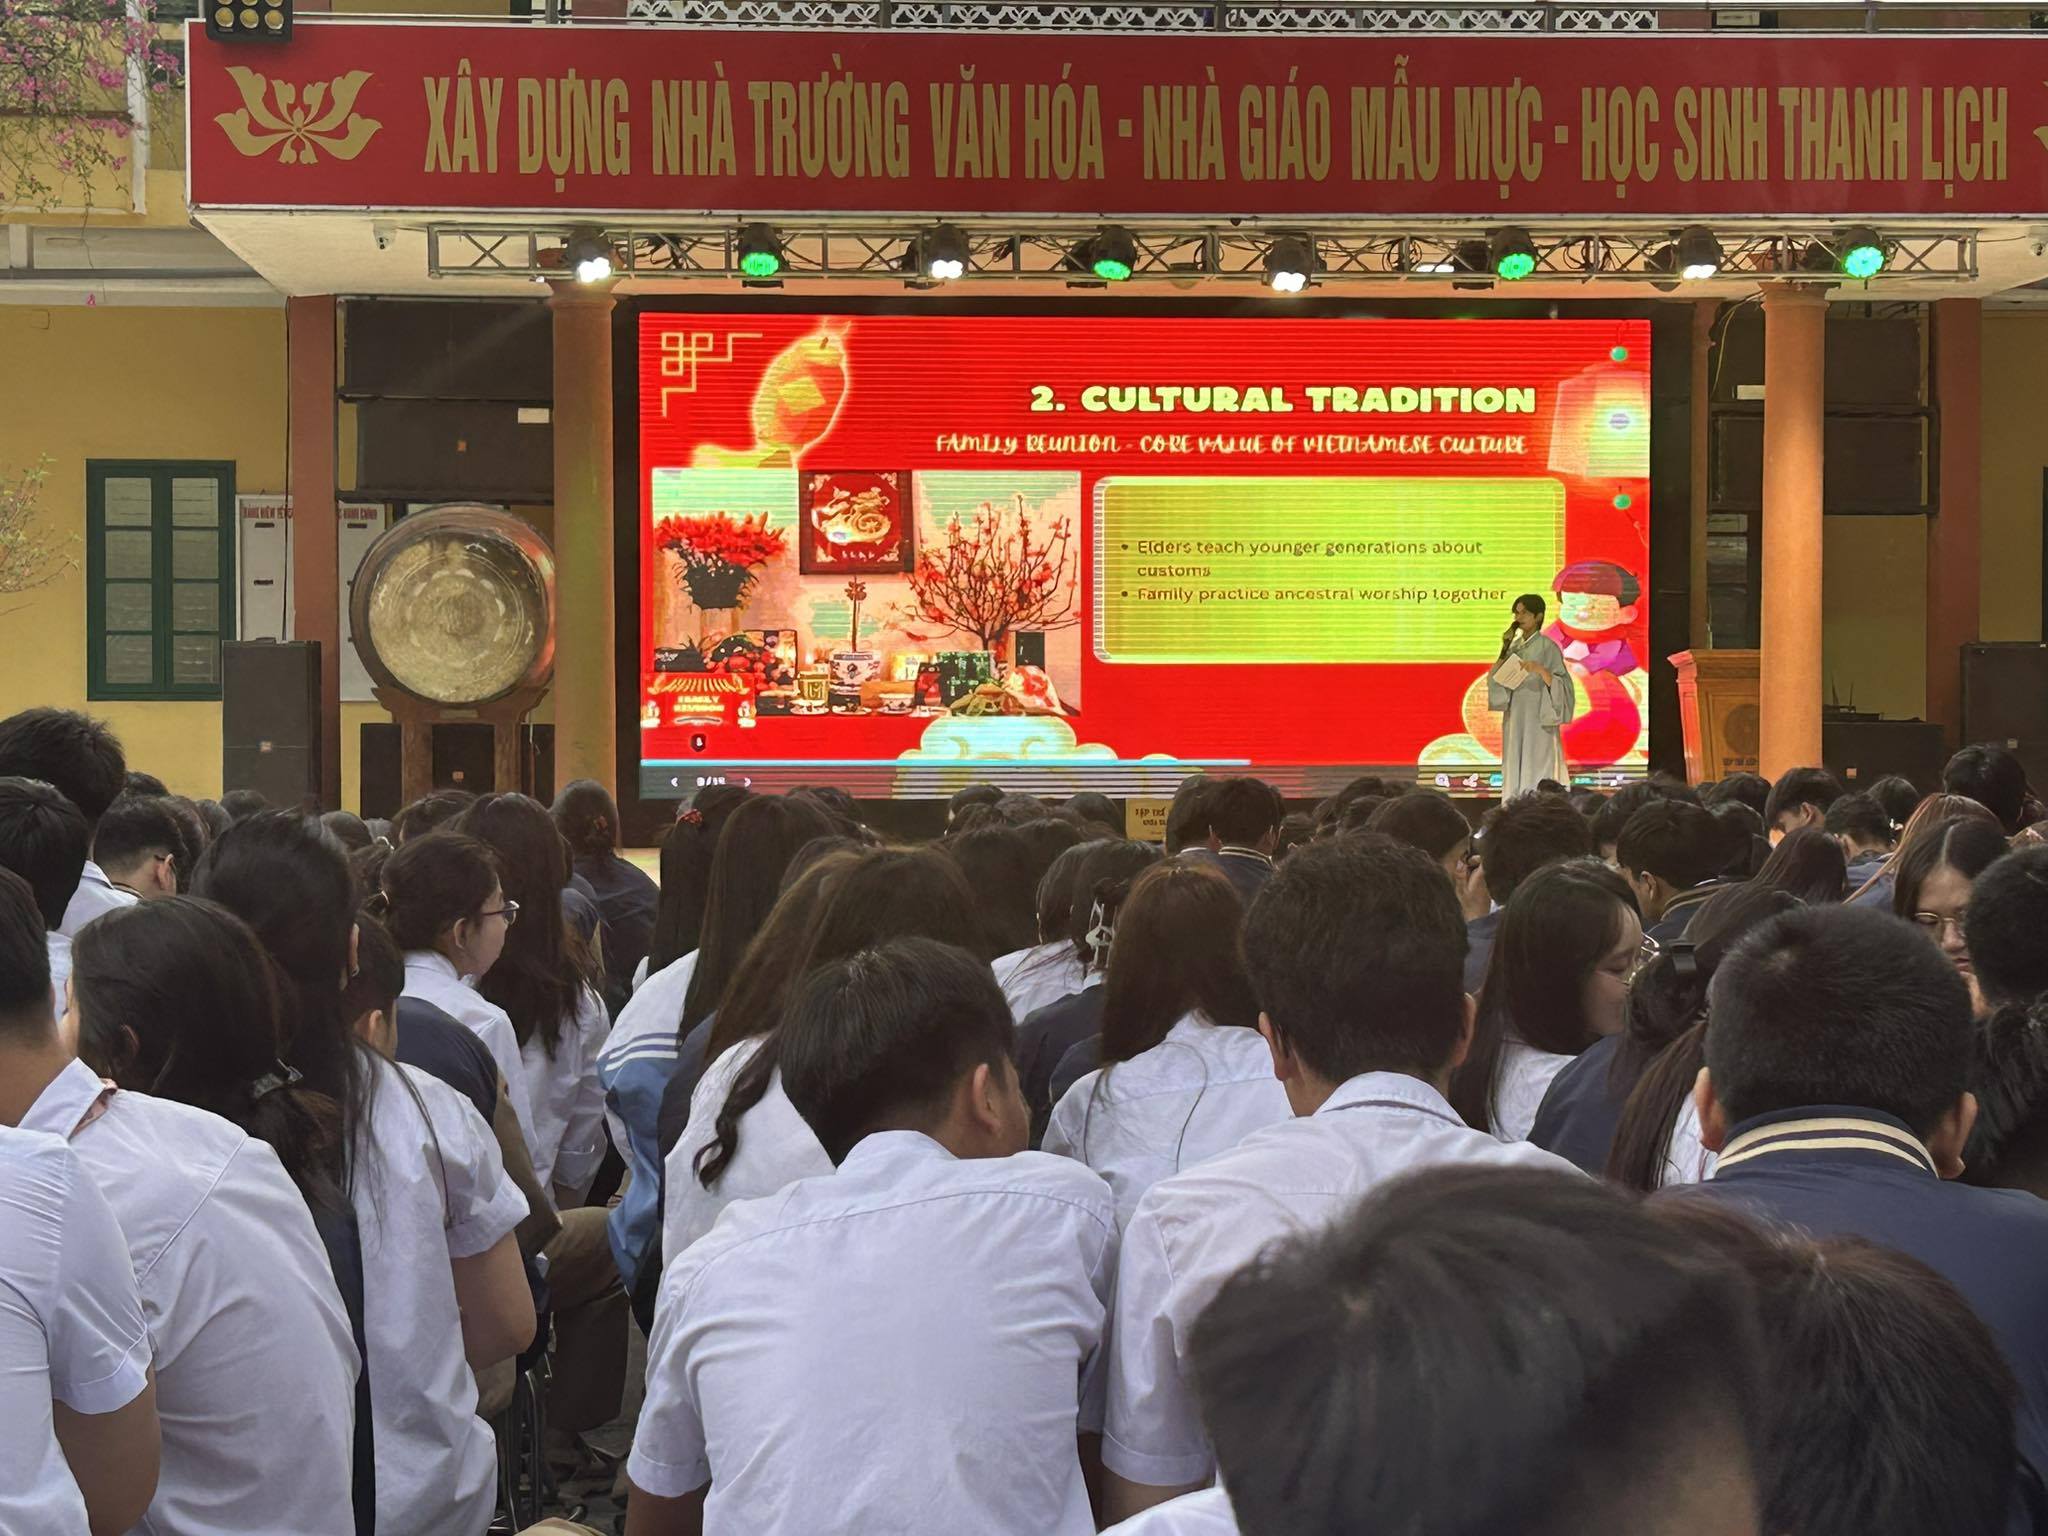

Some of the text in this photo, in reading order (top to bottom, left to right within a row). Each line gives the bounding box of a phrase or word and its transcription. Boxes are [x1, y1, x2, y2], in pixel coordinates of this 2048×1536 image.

[424, 57, 503, 174] XÂY
[518, 66, 630, 193] DỰNG
[652, 61, 737, 178] NHÀ
[748, 53, 910, 179] TRƯỜNG
[930, 63, 1011, 180] VĂN
[1024, 62, 1105, 180] HÓA
[1143, 64, 1226, 181] NHÀ
[1238, 65, 1331, 182] GIÁO
[1351, 53, 1441, 182] MẪU
[1455, 76, 1543, 199] MỰC
[1582, 86, 1660, 199] HỌC
[1673, 86, 1768, 182] SINH
[1778, 87, 1909, 182] THANH
[1921, 87, 2008, 198] LỊCH
[1030, 385, 1536, 413] 2. CULTURAL TRADITION
[936, 432, 1018, 455] FAMILY
[1026, 433, 1120, 454] REUNION
[1140, 434, 1193, 454] CORE
[1198, 433, 1265, 454] VALUE
[1271, 434, 1297, 453] OF
[1302, 433, 1434, 454] VIETNAMESE
[1439, 433, 1528, 454] CULTURE
[1137, 540, 1483, 557] Elders teach younger generations about
[1137, 564, 1211, 577] customs
[1137, 586, 1507, 604] Family practice ancestral worship together
